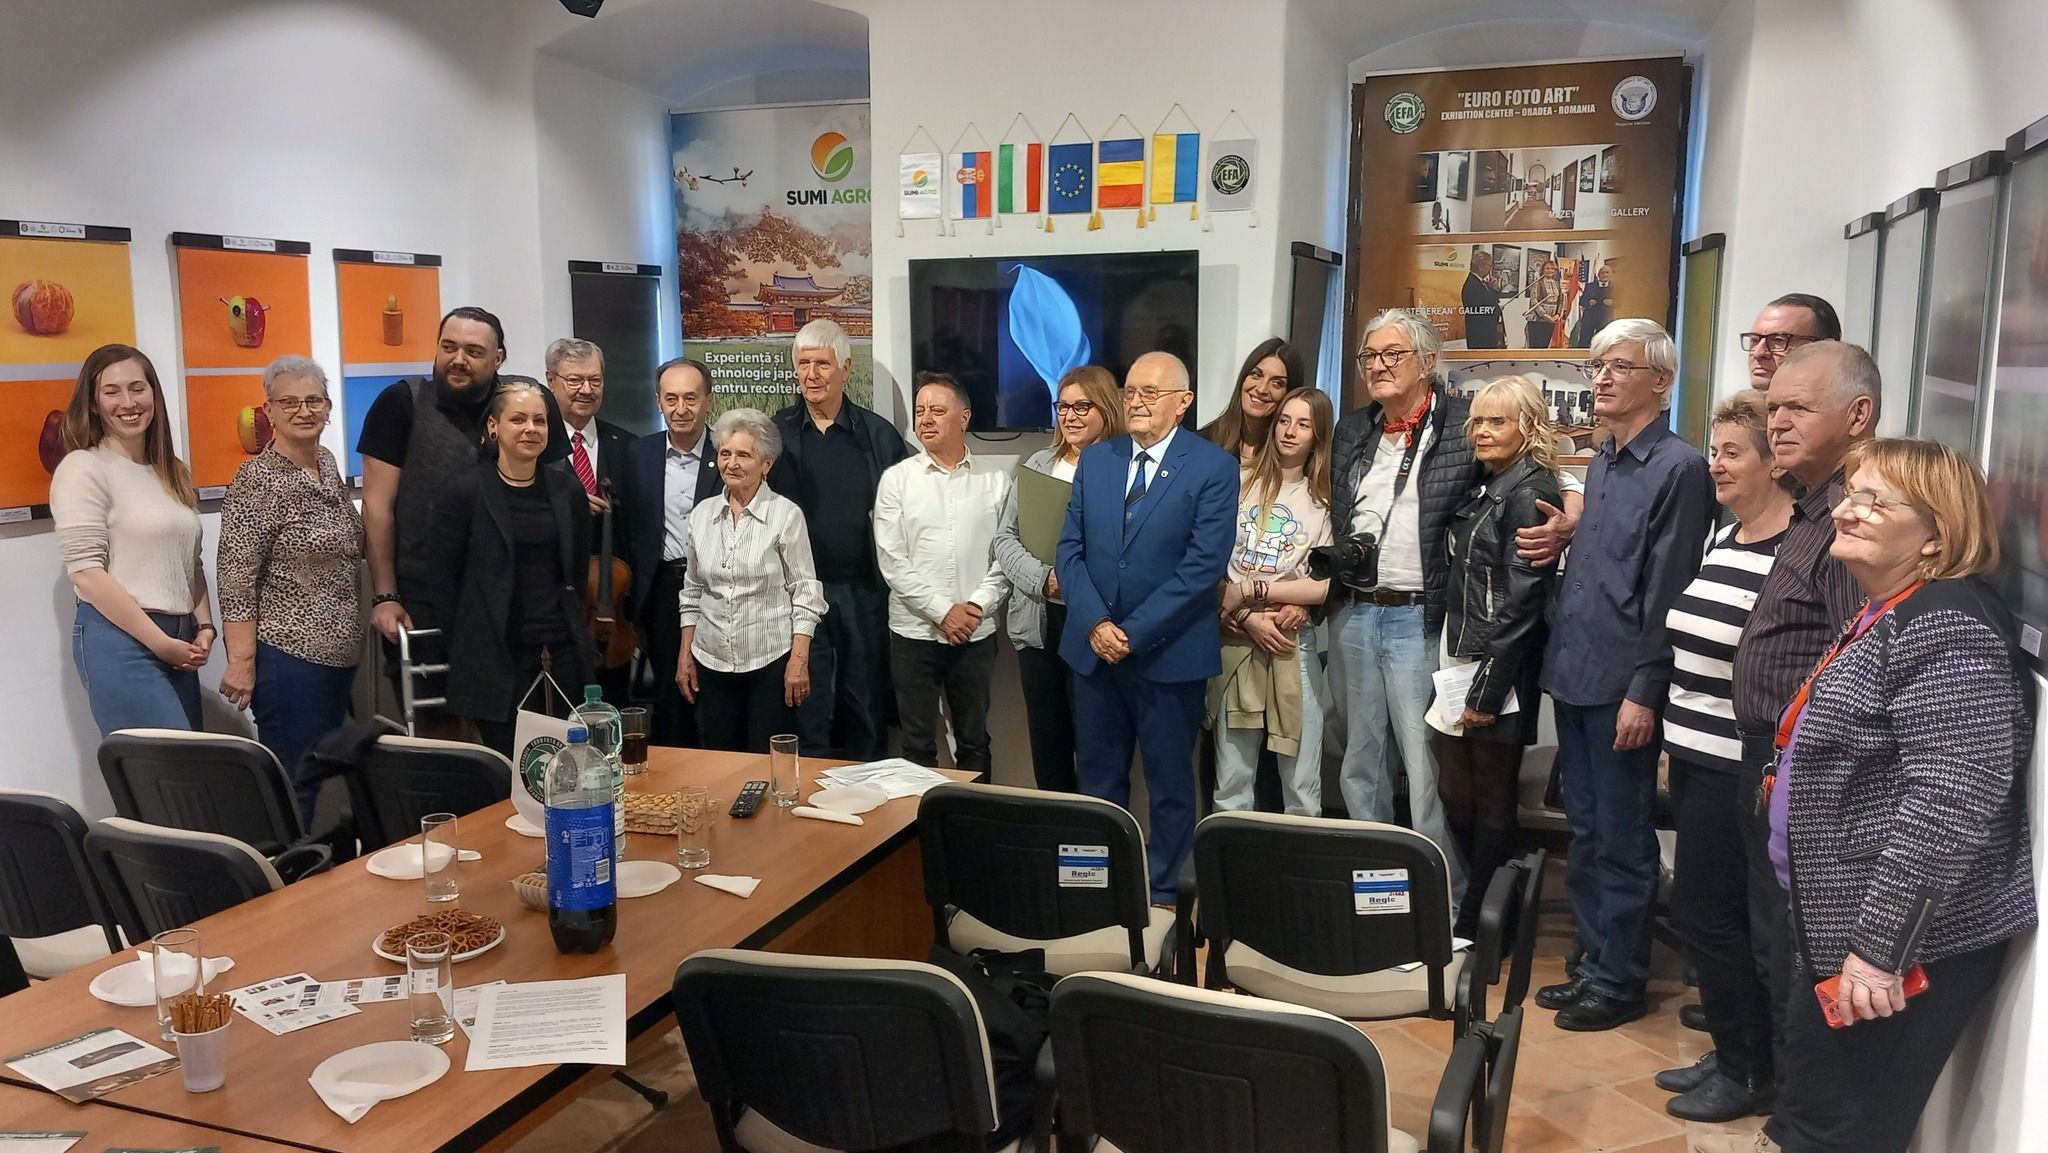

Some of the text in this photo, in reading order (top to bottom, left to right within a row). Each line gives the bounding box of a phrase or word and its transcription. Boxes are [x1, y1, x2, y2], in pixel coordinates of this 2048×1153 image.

[1505, 89, 1541, 106] FOTO
[1396, 107, 1414, 119] EFA
[1441, 110, 1484, 121] EXHIBITION
[1485, 108, 1514, 119] CENTER
[1522, 106, 1551, 117] ORADEA
[1558, 104, 1596, 115] ROMANIA
[1223, 169, 1239, 181] EFA
[787, 190, 828, 205] SUMI
[1611, 207, 1650, 217] GALLERY
[1459, 306, 1496, 316] GALLERY
[704, 351, 784, 366] Experiență și
[710, 367, 799, 381] ehnologie japo
